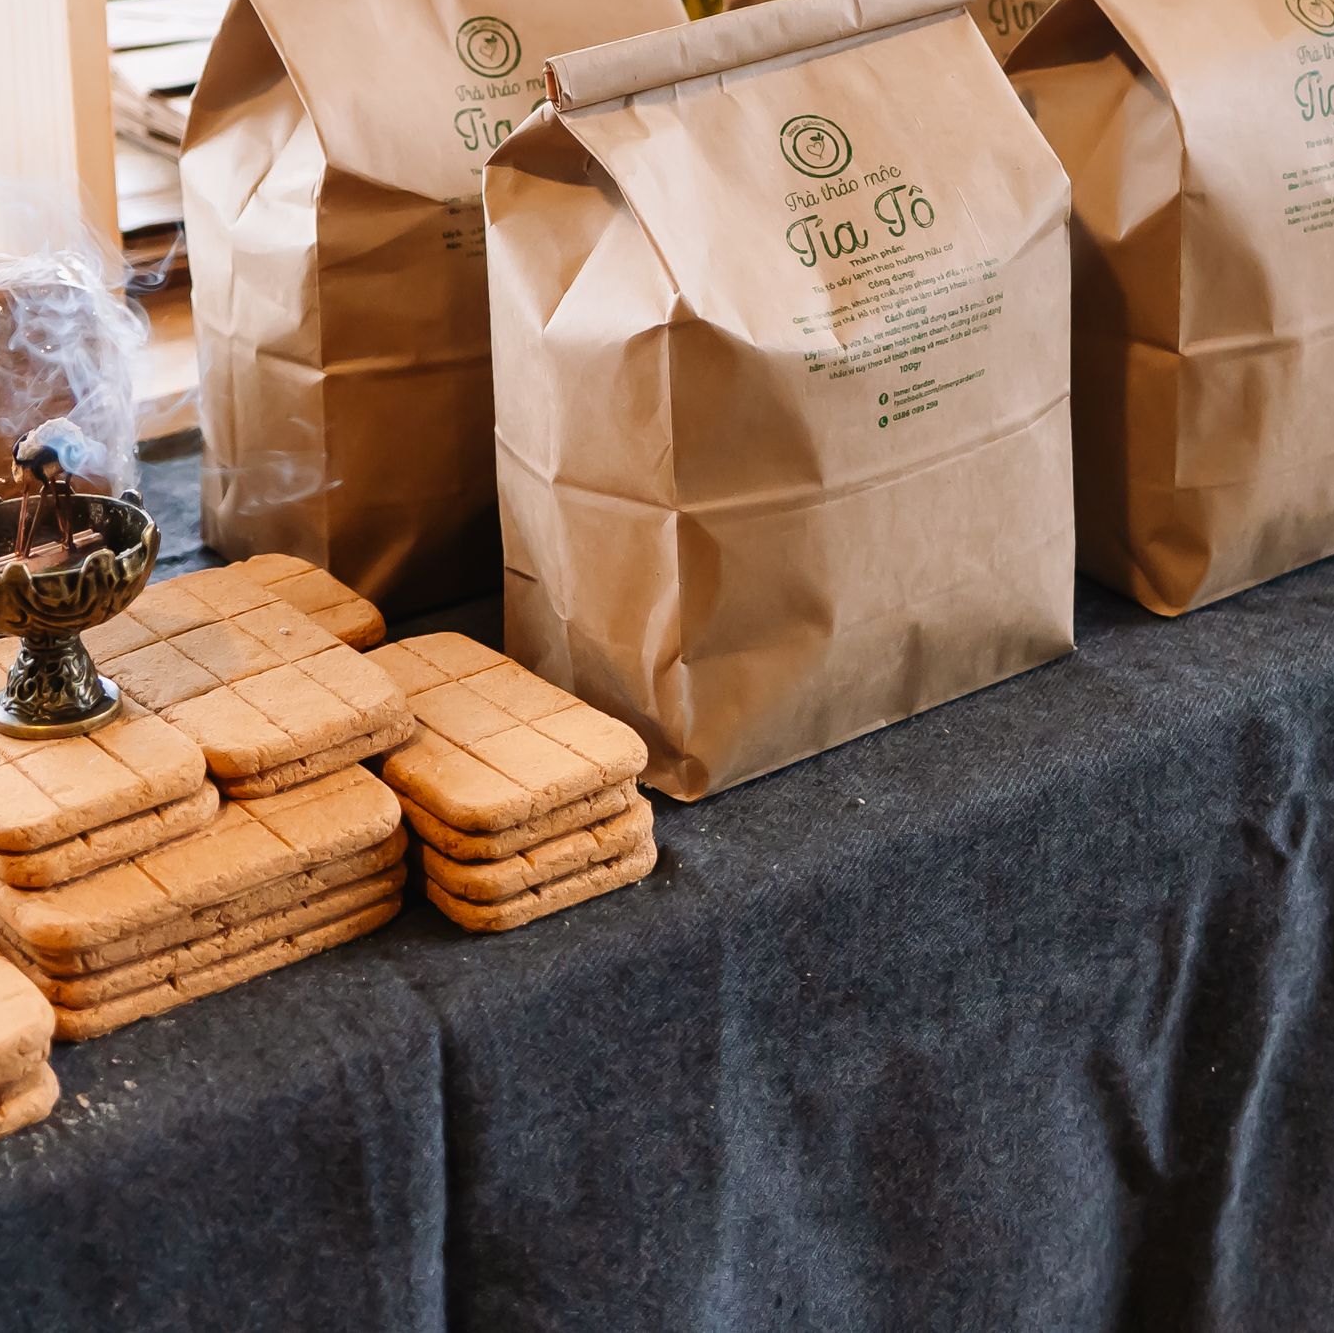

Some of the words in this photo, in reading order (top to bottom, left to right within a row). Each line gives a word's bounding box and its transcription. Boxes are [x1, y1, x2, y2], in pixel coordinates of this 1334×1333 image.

[487, 79, 521, 99] thảo
[784, 190, 820, 212] Trà
[820, 177, 859, 202] thảo
[863, 164, 902, 187] mộc
[785, 214, 869, 268] Tía
[873, 184, 936, 238] Tô
[849, 252, 879, 268] Thành
[899, 360, 922, 374] 100gr
